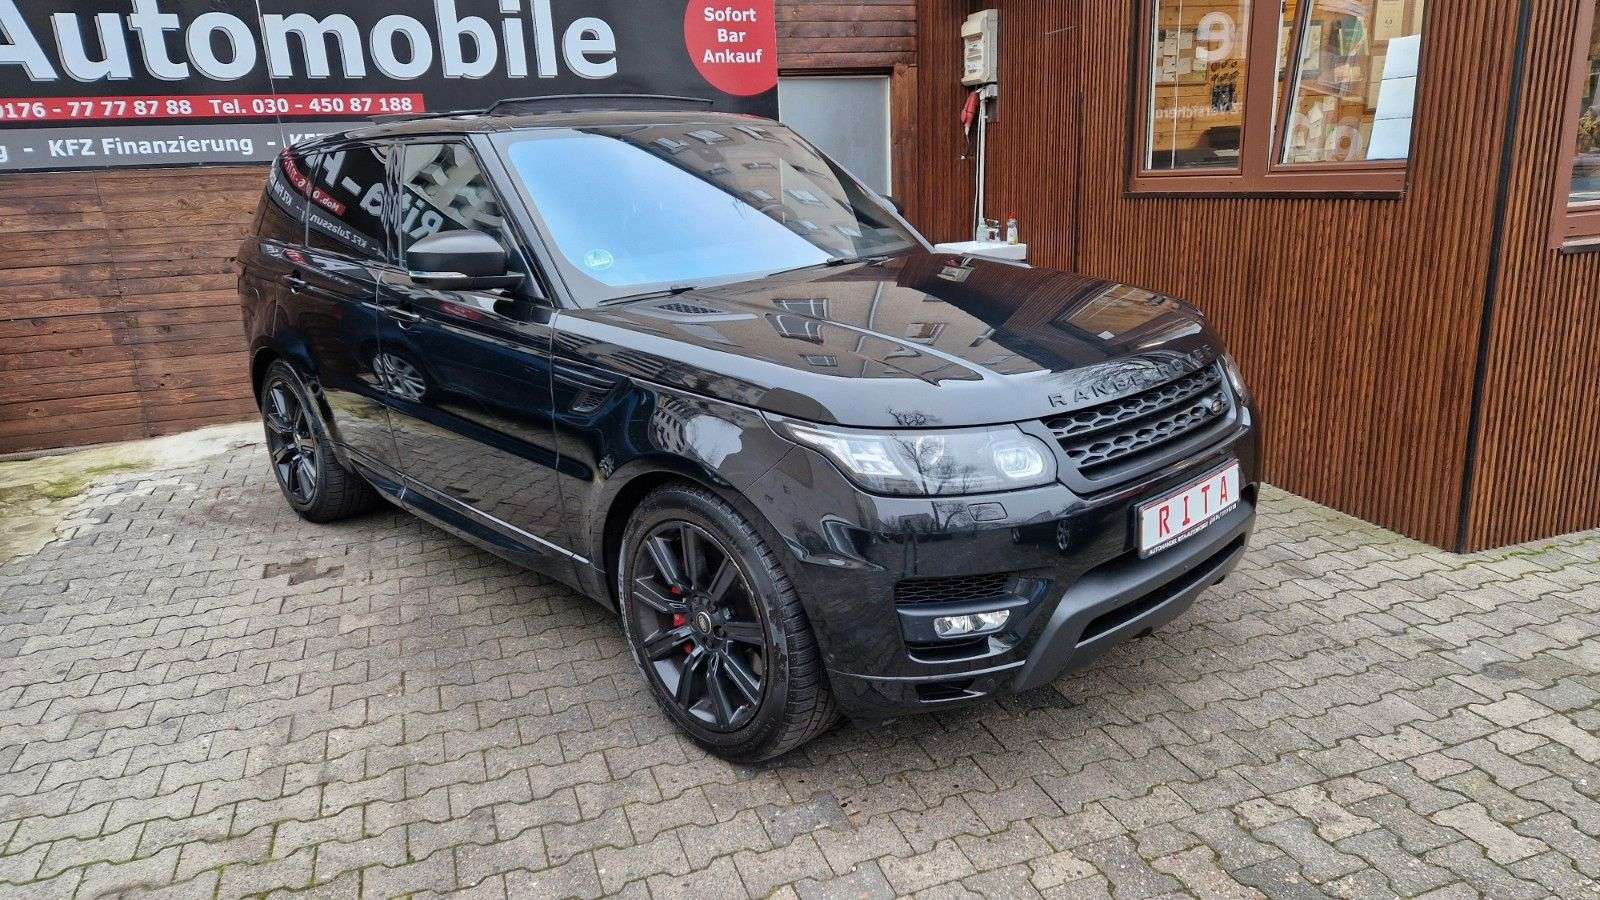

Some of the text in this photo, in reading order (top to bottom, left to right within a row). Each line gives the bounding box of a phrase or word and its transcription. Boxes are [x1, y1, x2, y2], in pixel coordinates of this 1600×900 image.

[704, 6, 757, 22] Sofort
[0, 0, 617, 82] Automobile
[717, 28, 746, 43] Bar
[703, 48, 763, 64] Ankauf
[0, 101, 46, 118] 176
[67, 101, 93, 117] 77
[100, 100, 126, 116] 77
[133, 100, 158, 115] 87
[165, 99, 192, 115] 88
[209, 99, 246, 114] Tel.
[252, 98, 289, 113] 030
[309, 98, 344, 112] 450
[350, 97, 372, 112] 87
[379, 97, 412, 112] 188
[49, 138, 96, 157] KFZ
[101, 135, 254, 155] Finanzierung
[1159, 475, 1228, 538] RITA
